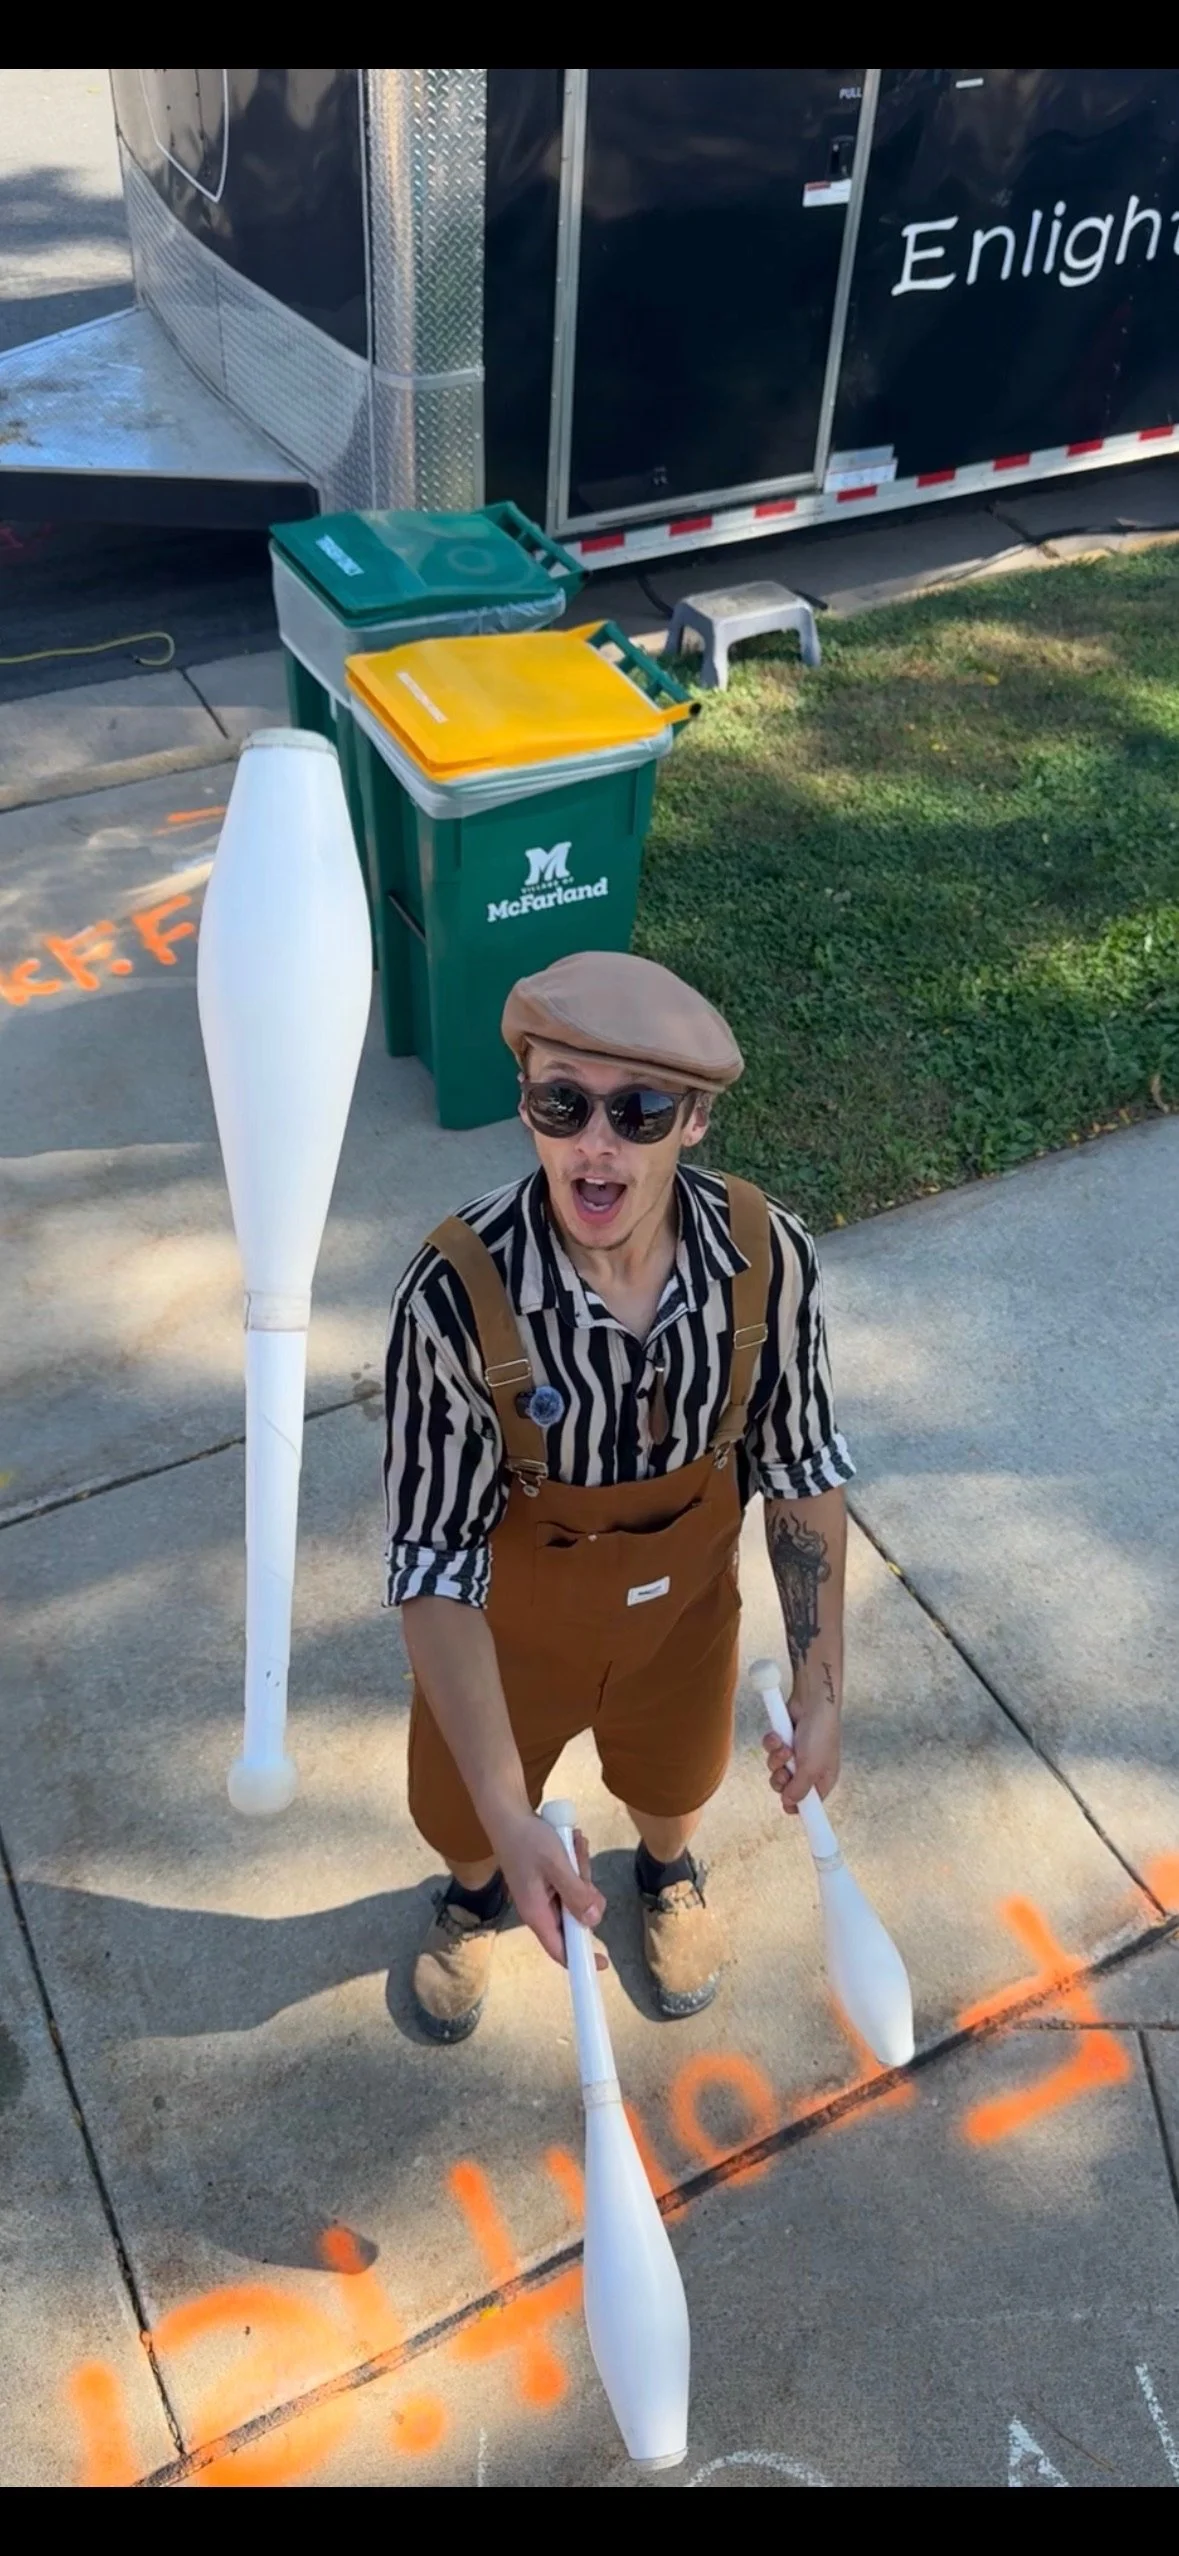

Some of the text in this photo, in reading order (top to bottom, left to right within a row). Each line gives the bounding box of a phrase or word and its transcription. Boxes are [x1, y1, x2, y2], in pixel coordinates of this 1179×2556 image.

[840, 87, 862, 99] PULL
[891, 195, 1179, 296] Enligh
[487, 877, 608, 922] McFarland
